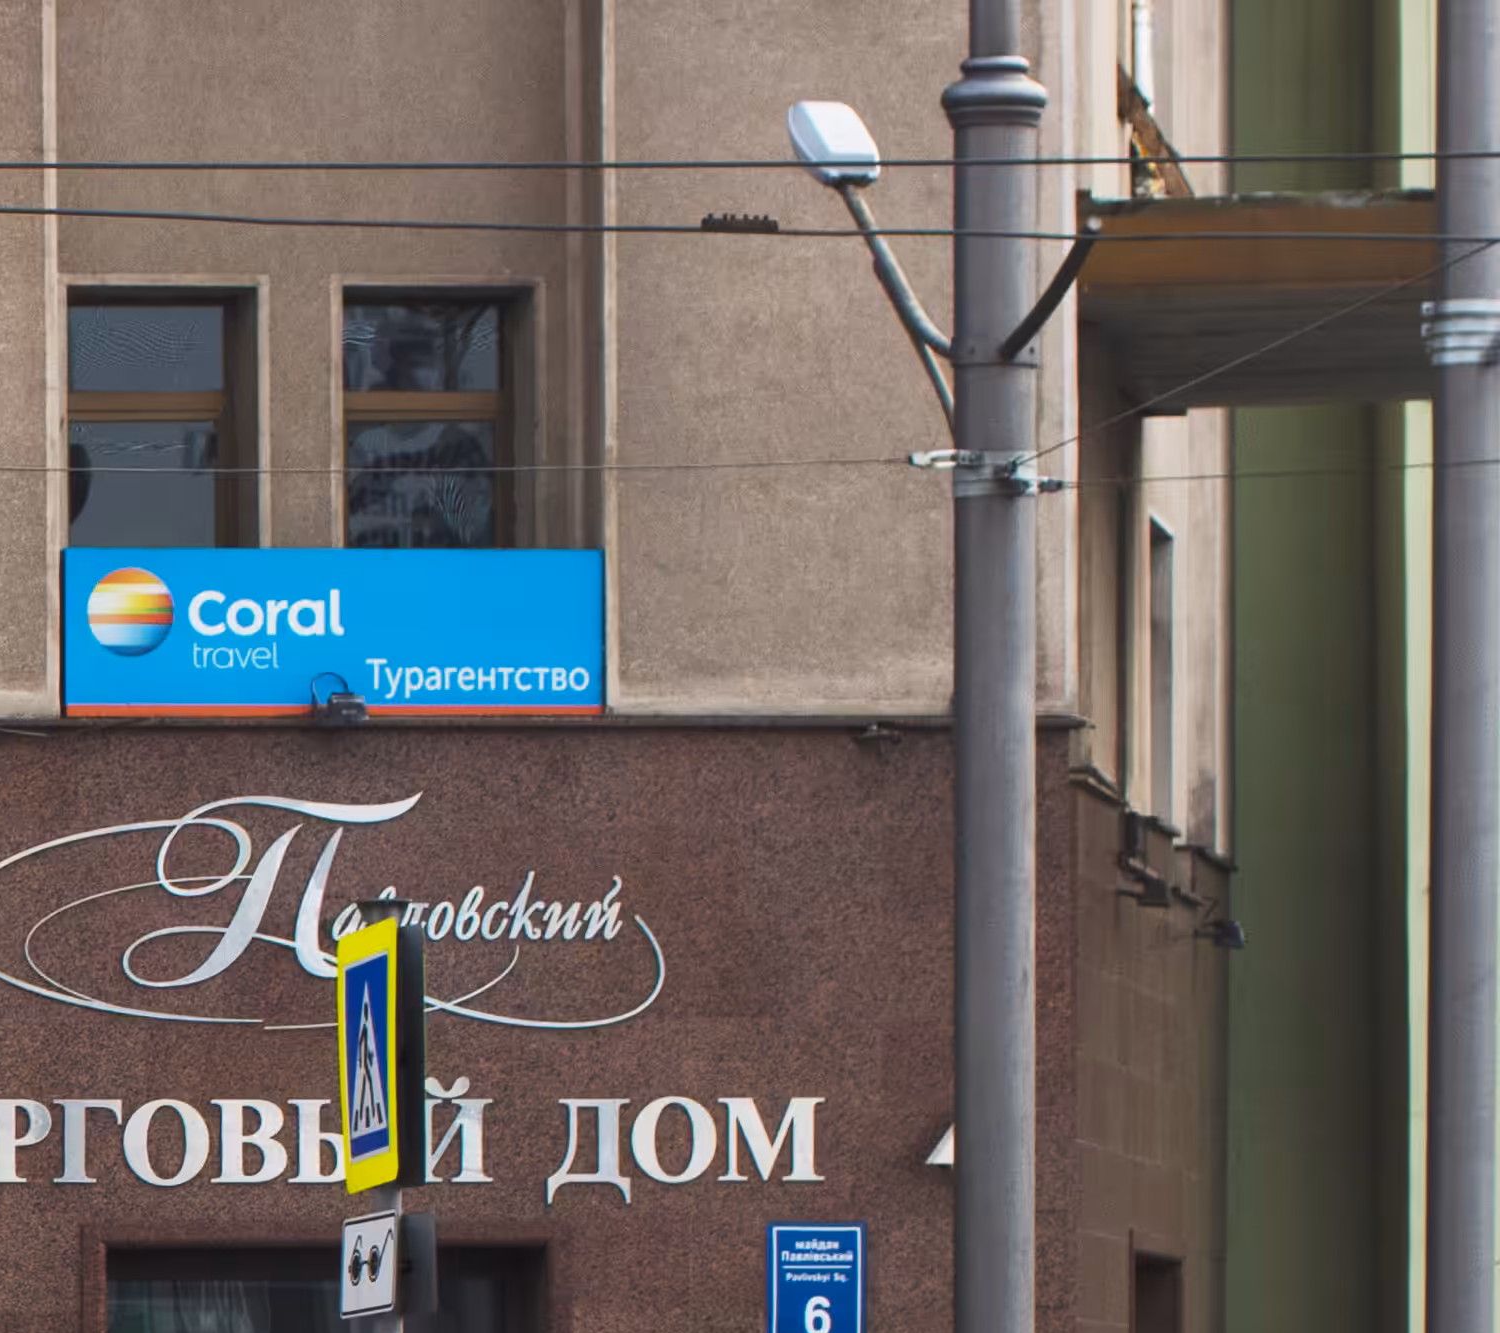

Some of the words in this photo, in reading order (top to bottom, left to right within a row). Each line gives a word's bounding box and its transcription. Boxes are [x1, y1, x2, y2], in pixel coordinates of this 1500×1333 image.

[188, 588, 345, 638] Coral
[192, 641, 279, 670] travel
[365, 657, 590, 698] Турагентство
[100, 790, 628, 992] Паловский
[546, 1095, 827, 1204] ДОМ
